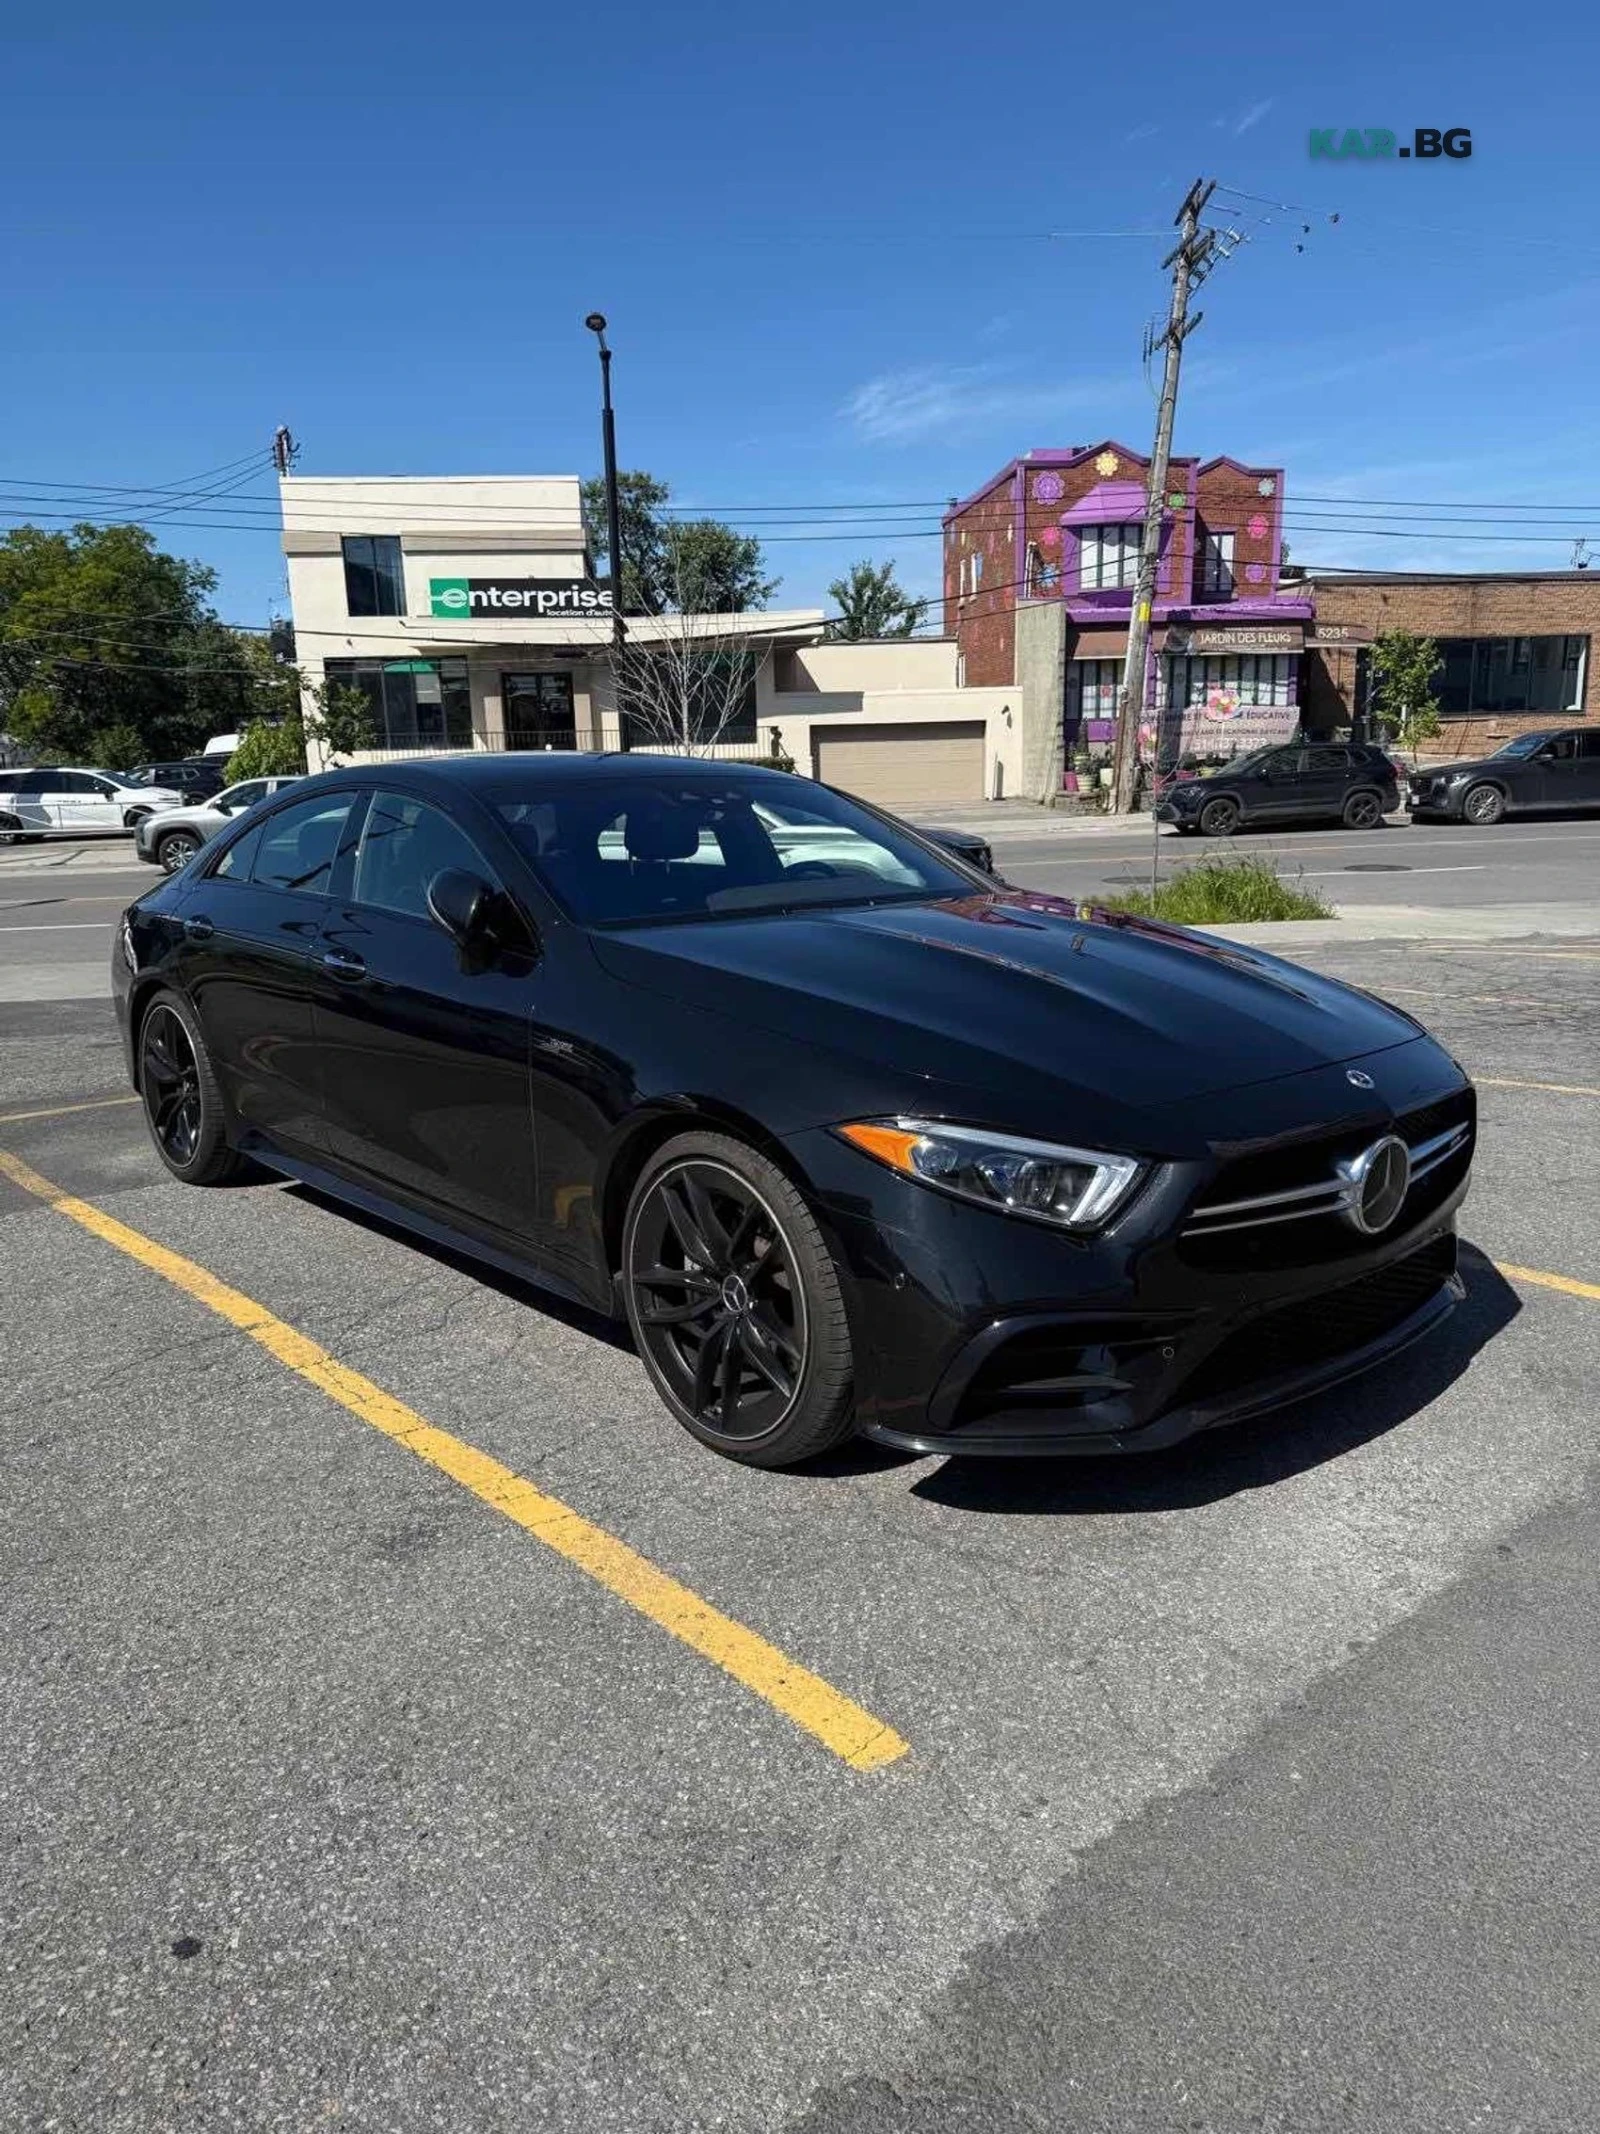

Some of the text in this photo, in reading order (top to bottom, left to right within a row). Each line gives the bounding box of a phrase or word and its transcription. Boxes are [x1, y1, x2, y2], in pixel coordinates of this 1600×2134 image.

[431, 584, 614, 613] enterprise
[547, 608, 584, 616] location
[1200, 632, 1292, 644] JARDIN DES FLEURS
[1318, 627, 1348, 639] 5235
